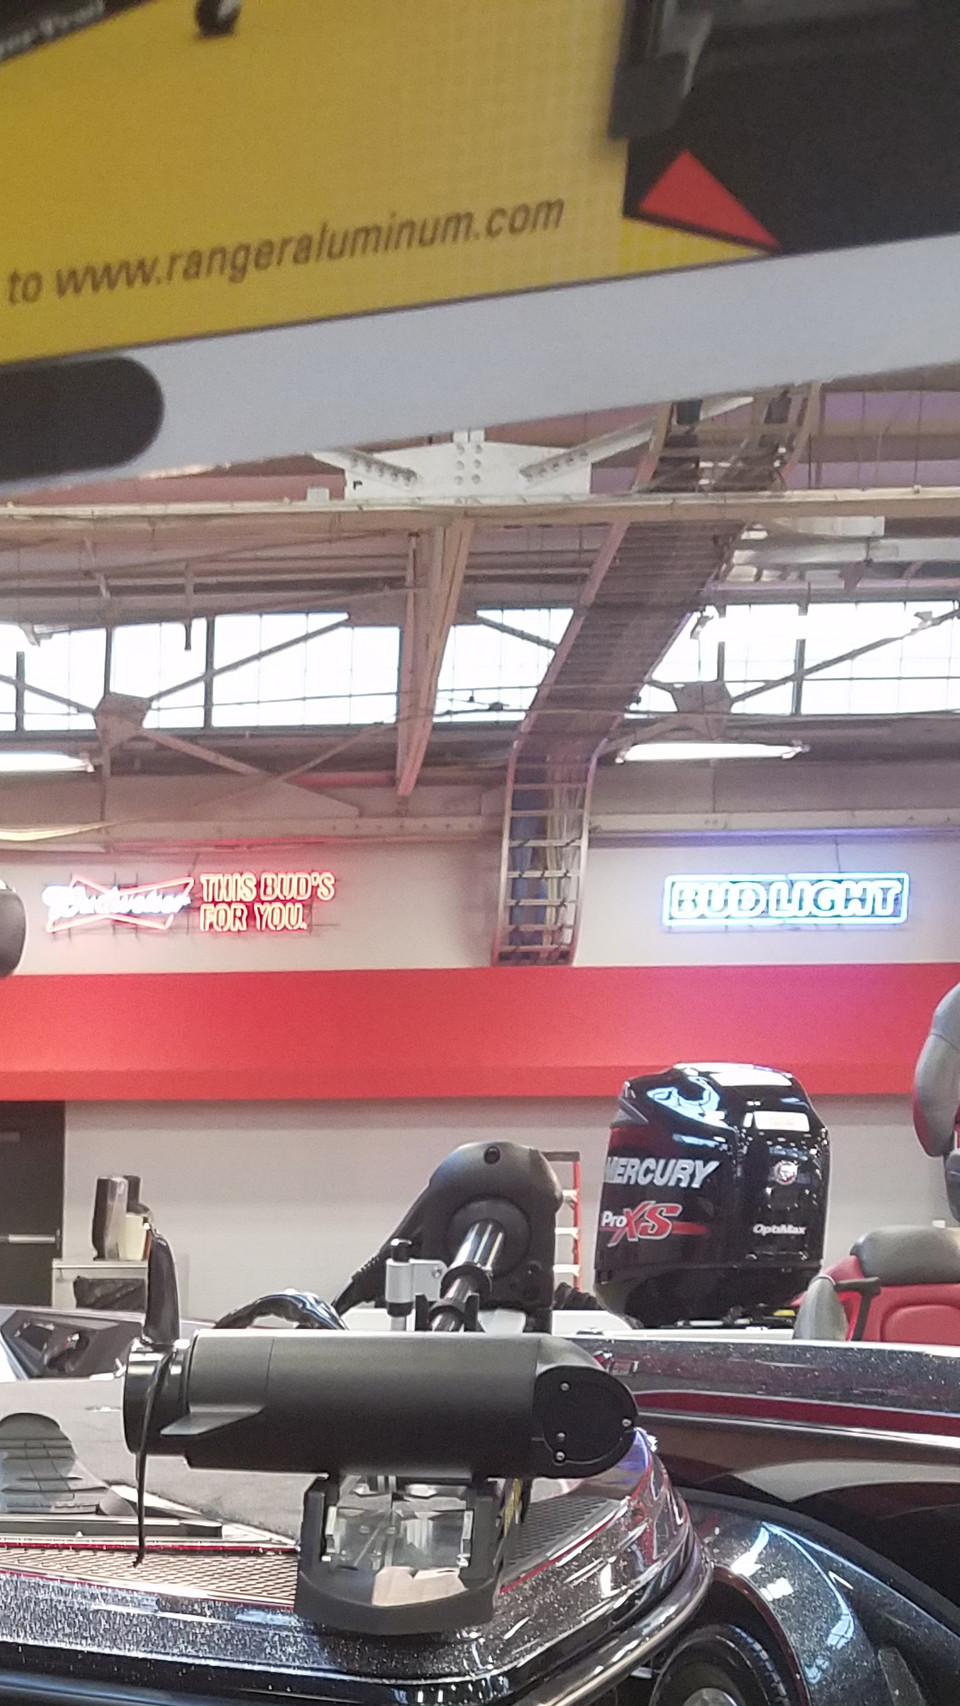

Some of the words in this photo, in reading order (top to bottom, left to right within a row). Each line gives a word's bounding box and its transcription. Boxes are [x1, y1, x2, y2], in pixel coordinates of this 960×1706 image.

[8, 268, 42, 305] to
[54, 197, 566, 298] www.rangeraluminum.com
[199, 873, 257, 902] THIS
[259, 871, 336, 902] BUD'S
[670, 881, 767, 919] BUD
[768, 879, 903, 917] LIGHT
[199, 903, 248, 932] FOR
[254, 902, 309, 931] YOU.
